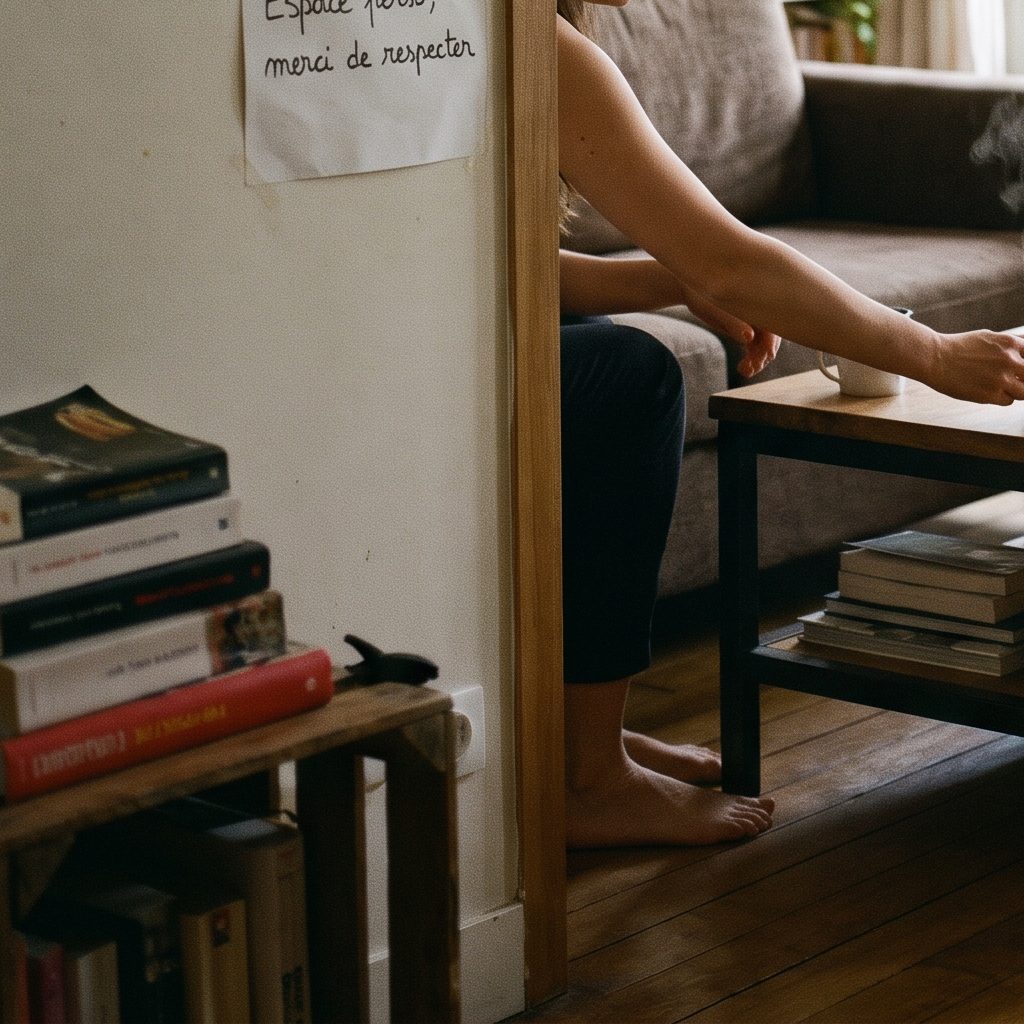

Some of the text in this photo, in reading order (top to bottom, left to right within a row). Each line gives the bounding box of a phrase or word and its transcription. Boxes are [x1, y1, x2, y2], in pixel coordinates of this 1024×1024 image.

[265, 28, 475, 78] merci de respecter
